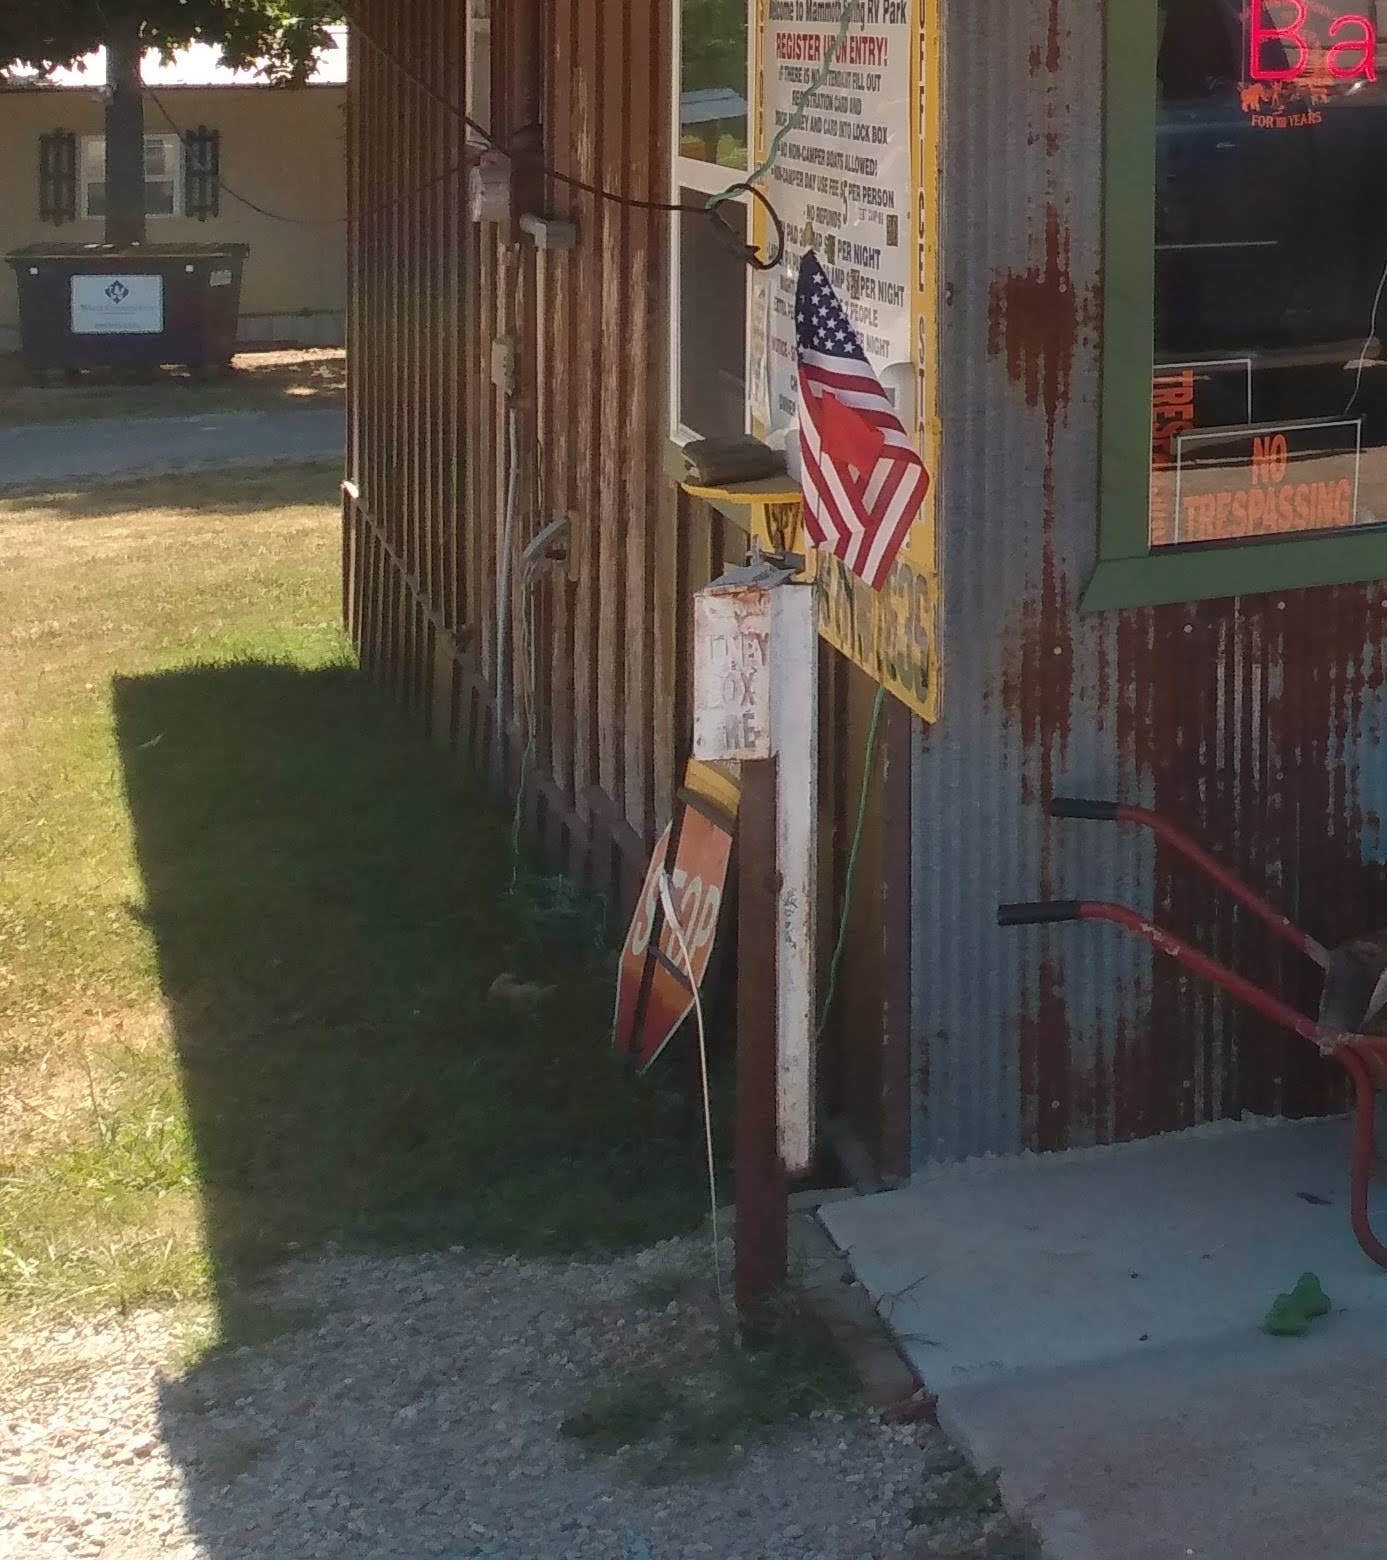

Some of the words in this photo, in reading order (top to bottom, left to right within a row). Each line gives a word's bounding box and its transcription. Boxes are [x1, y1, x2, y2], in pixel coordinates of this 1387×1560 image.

[776, 32, 821, 61] REGISTER
[849, 36, 888, 66] ENTRY!
[866, 72, 882, 92] OUT
[1251, 113, 1273, 128] FOR
[1288, 110, 1322, 126] YEARS
[853, 123, 870, 142] LOCK
[871, 125, 888, 145] BOX
[849, 180, 862, 203] PER
[862, 184, 895, 209] PERSON
[837, 239, 852, 261] PER
[853, 243, 881, 270] NIGHT
[860, 277, 876, 301] PER
[878, 282, 905, 308] NIGHT
[850, 301, 879, 327] PEOPLE
[866, 333, 890, 358] NIGHT
[1252, 434, 1289, 484] NO
[1183, 478, 1351, 534] TRESPASSING
